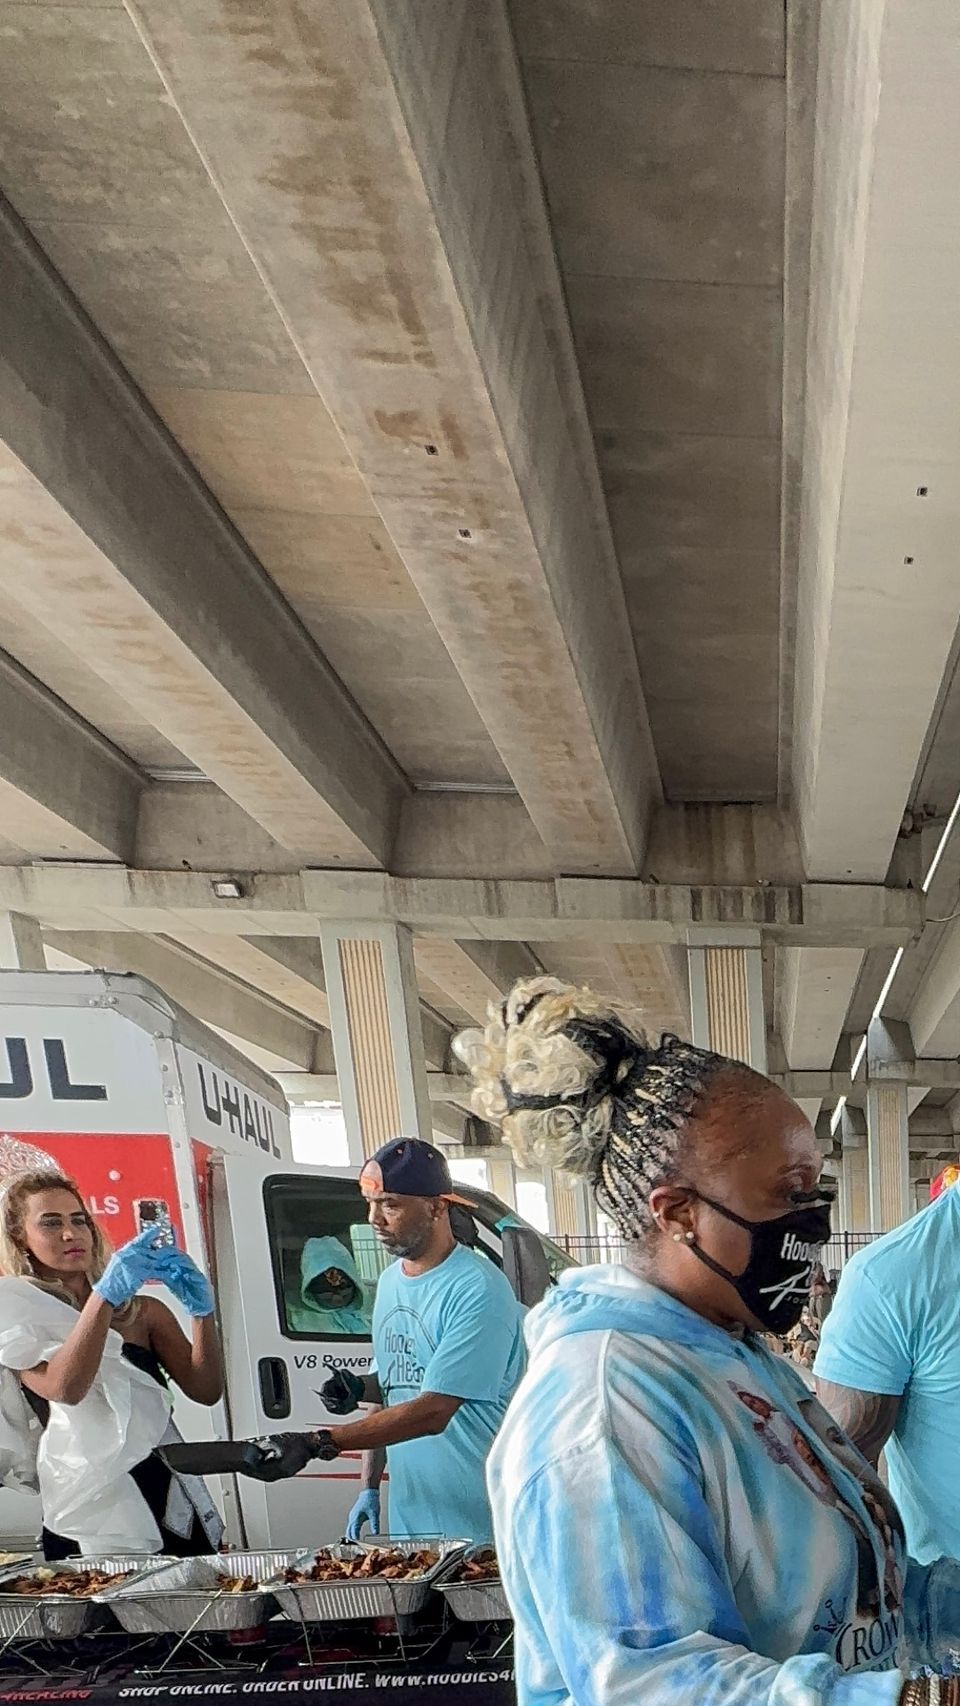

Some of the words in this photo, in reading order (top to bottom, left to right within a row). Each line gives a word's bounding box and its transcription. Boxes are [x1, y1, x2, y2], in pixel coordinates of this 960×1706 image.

[88, 1196, 120, 1215] LS
[294, 1355, 317, 1369] V8
[322, 1354, 374, 1368] Power
[303, 1672, 369, 1690] ONLINE.
